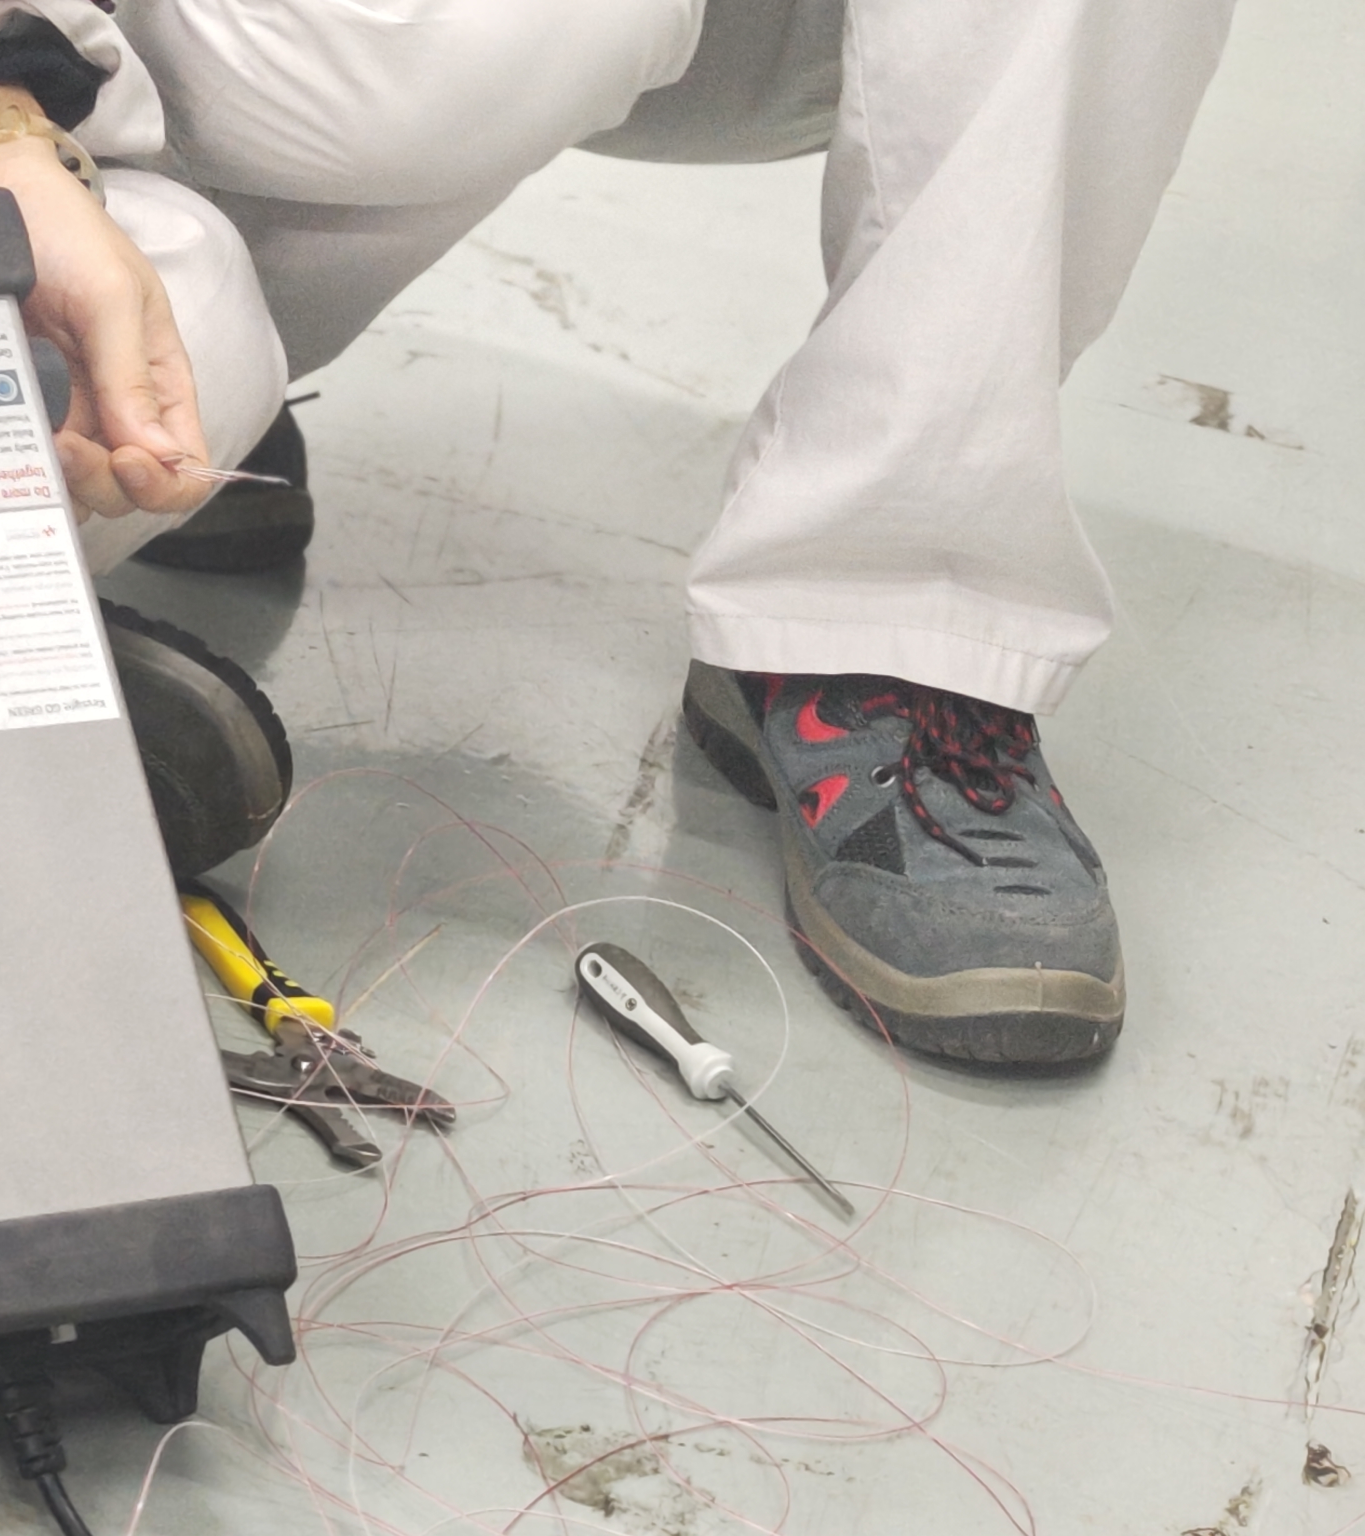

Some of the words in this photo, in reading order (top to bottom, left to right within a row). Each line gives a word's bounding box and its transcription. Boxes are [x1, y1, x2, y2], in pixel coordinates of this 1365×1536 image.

[0, 487, 32, 500] more
[32, 485, 51, 498] Do
[6, 704, 43, 717] GREEN
[44, 702, 61, 713] GO
